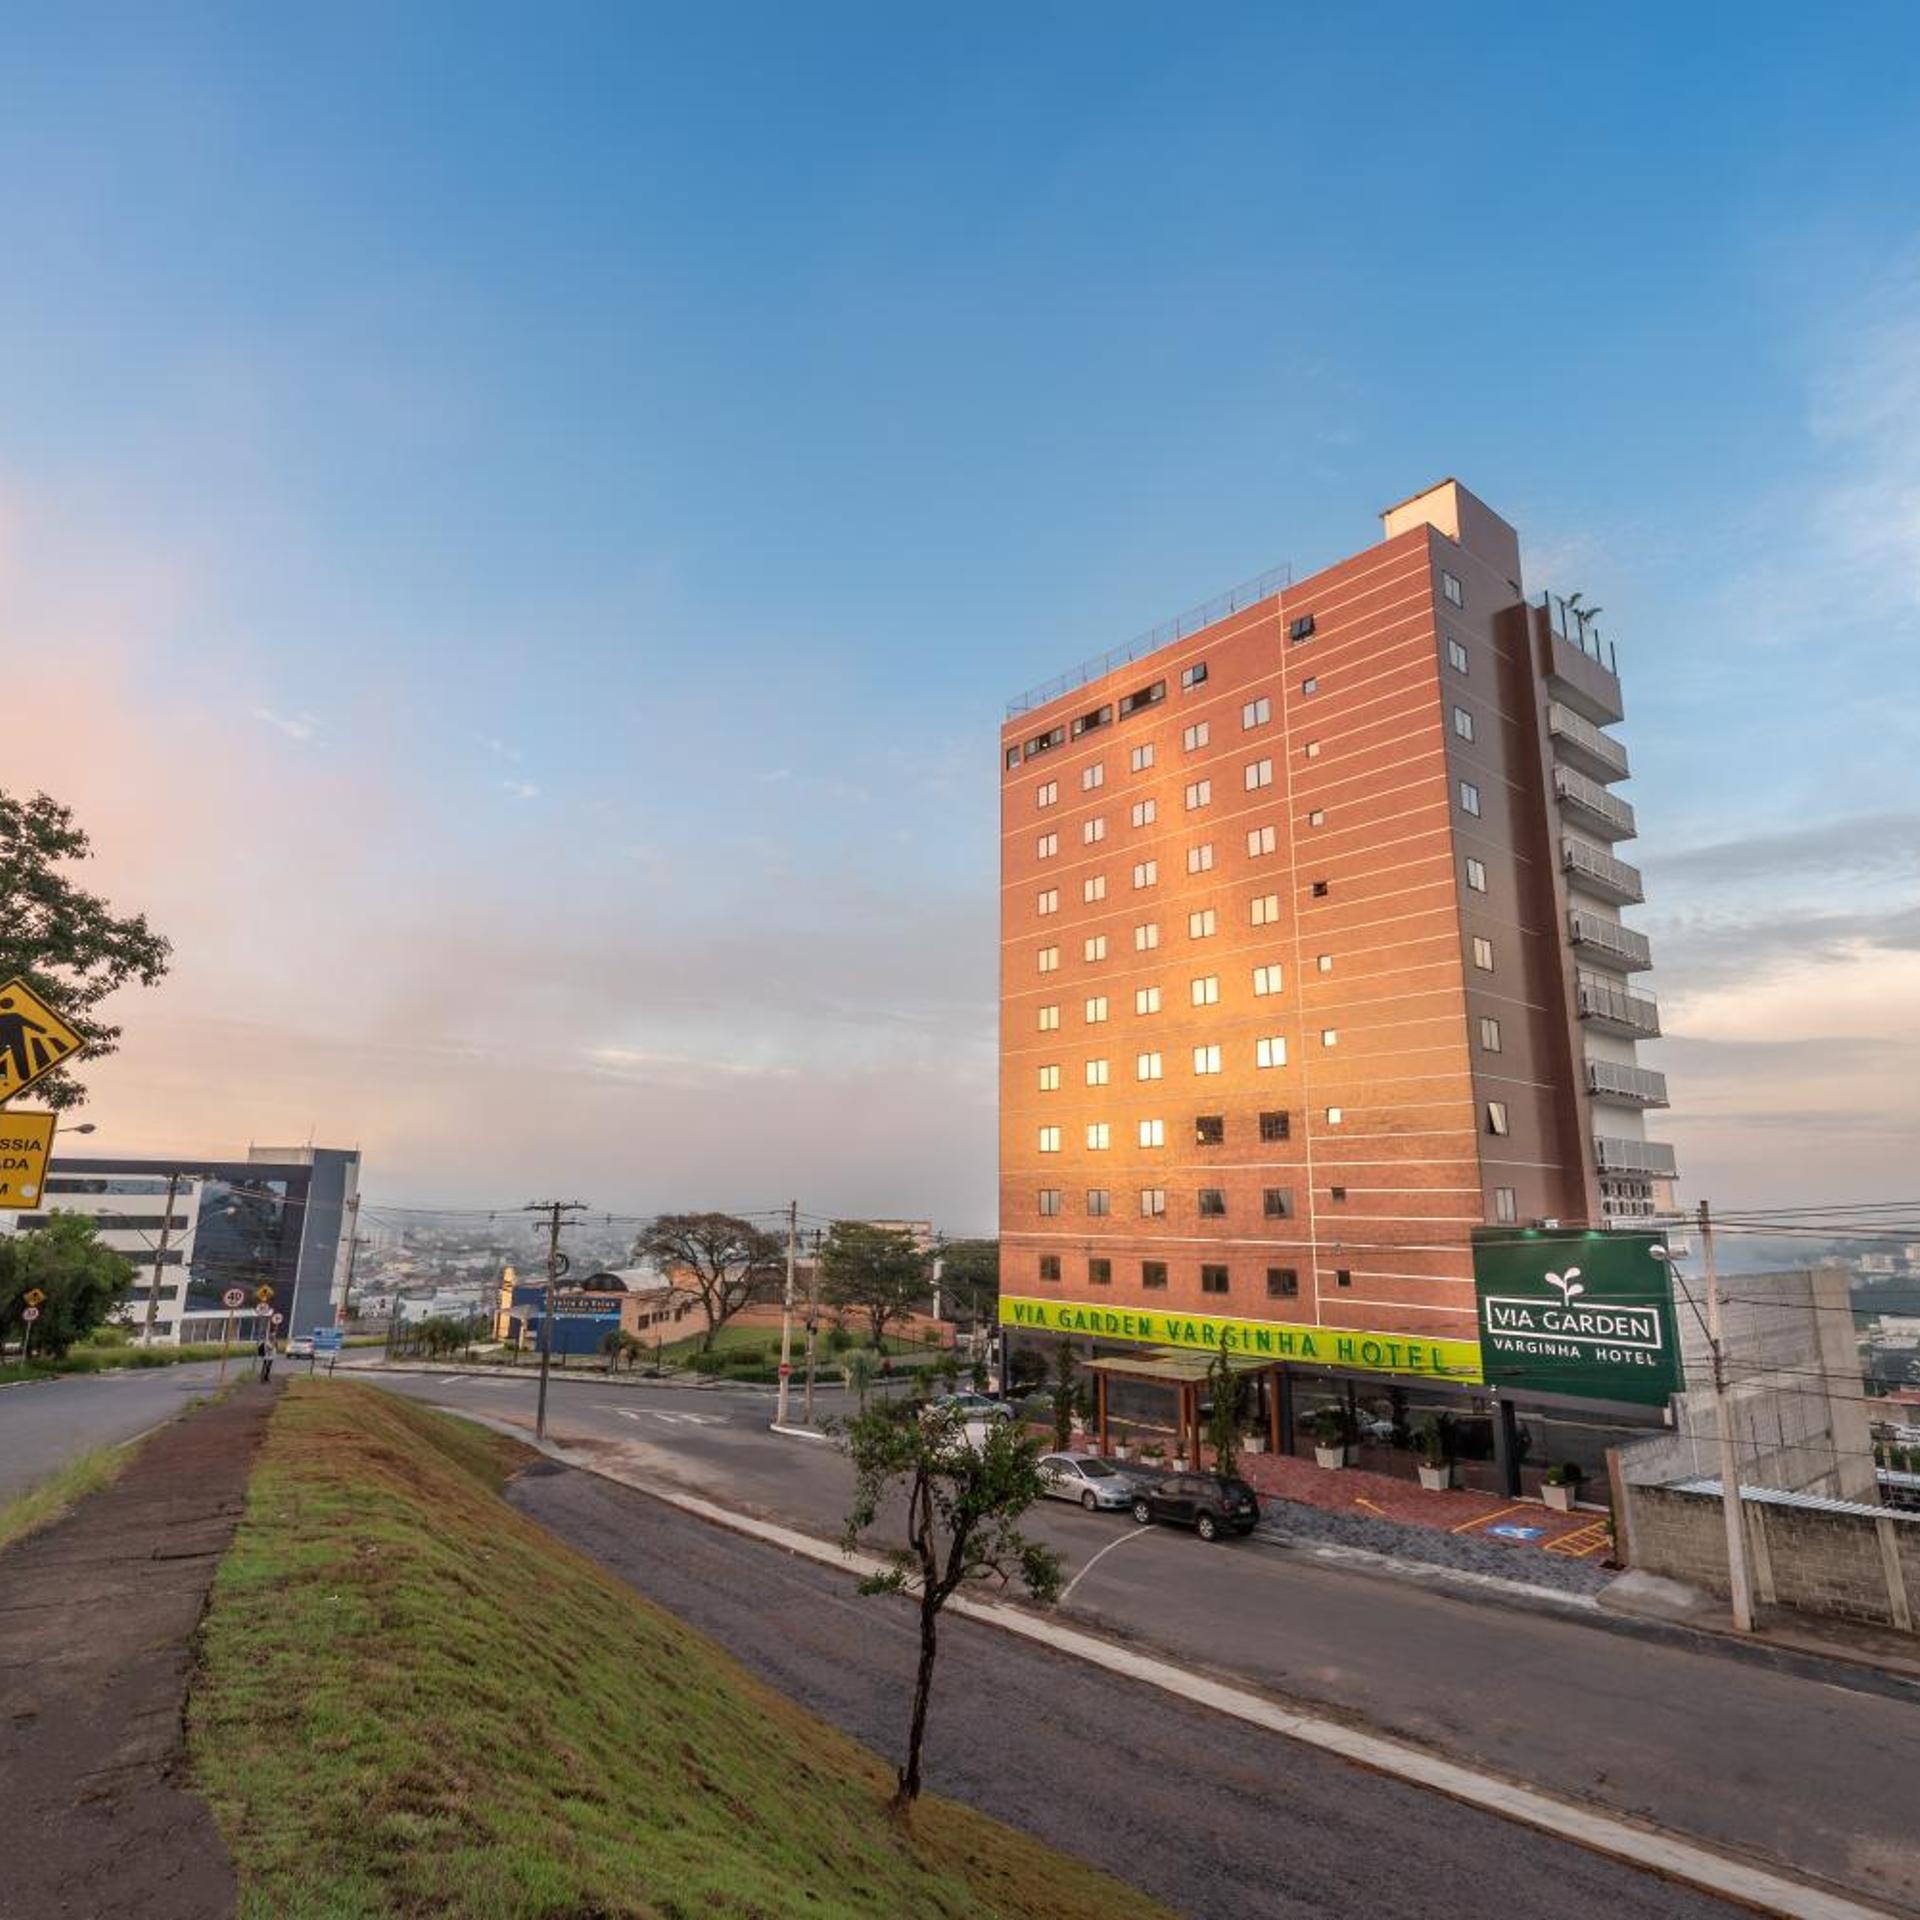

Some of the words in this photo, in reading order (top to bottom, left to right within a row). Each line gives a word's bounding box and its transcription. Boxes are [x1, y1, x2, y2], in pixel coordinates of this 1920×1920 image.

[1013, 1303, 1046, 1326] VIA
[1059, 1308, 1152, 1338] GARDEN
[1165, 1317, 1319, 1358] VARGINHA
[1337, 1338, 1445, 1373] HOTEL
[1494, 1307, 1534, 1328] VIA
[1543, 1311, 1651, 1338] GARDEN
[1493, 1338, 1581, 1359] VARGINHA
[1596, 1347, 1657, 1366] HOTEL
